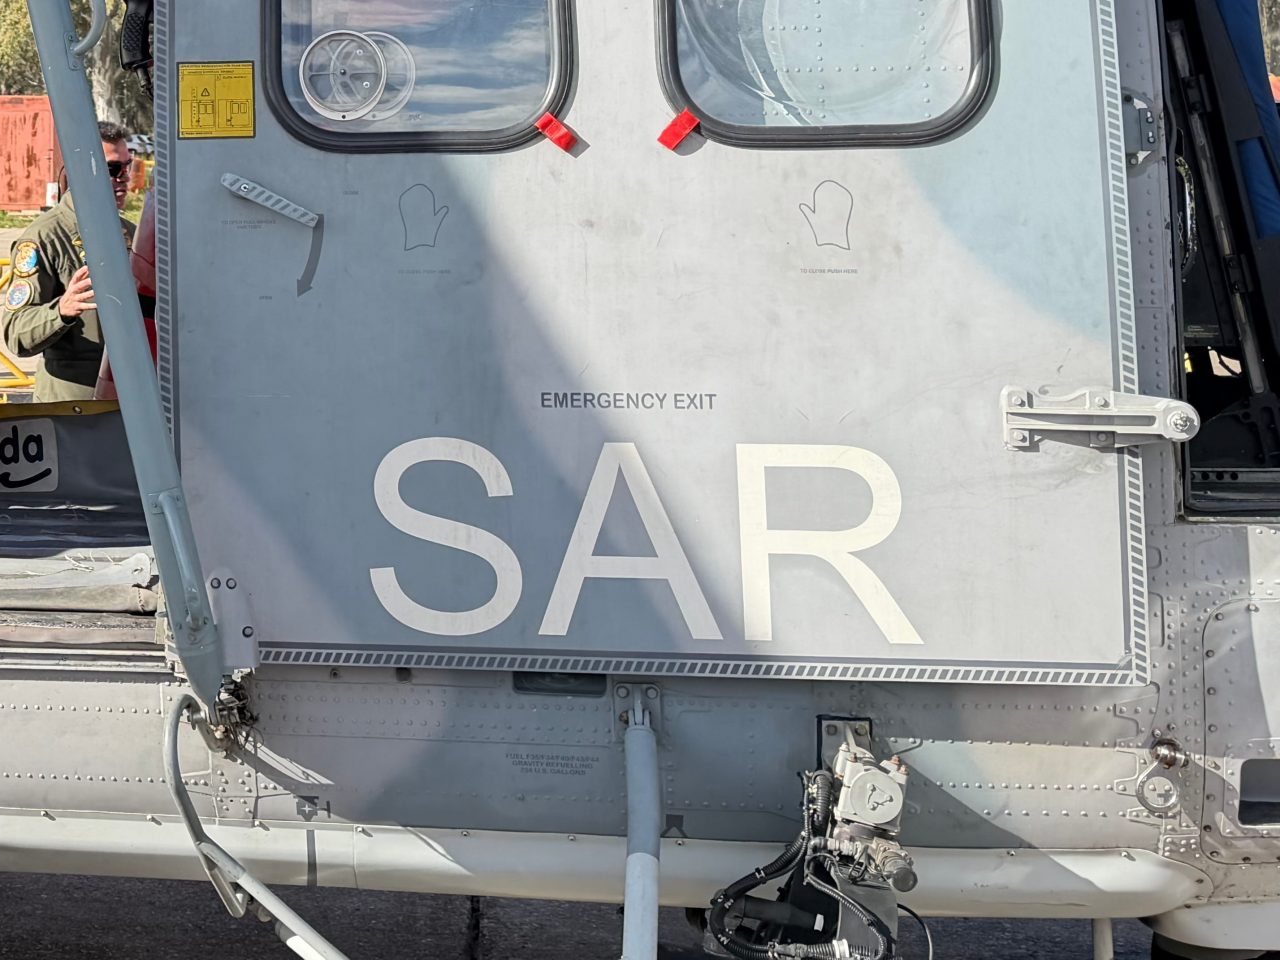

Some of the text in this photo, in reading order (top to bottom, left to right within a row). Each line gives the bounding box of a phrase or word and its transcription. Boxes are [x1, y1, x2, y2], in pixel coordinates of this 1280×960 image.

[540, 391, 718, 411] EMERGENCY EXIT
[370, 437, 925, 644] SAR
[545, 761, 593, 769] REFUELLING
[550, 768, 586, 776] GALLONS
